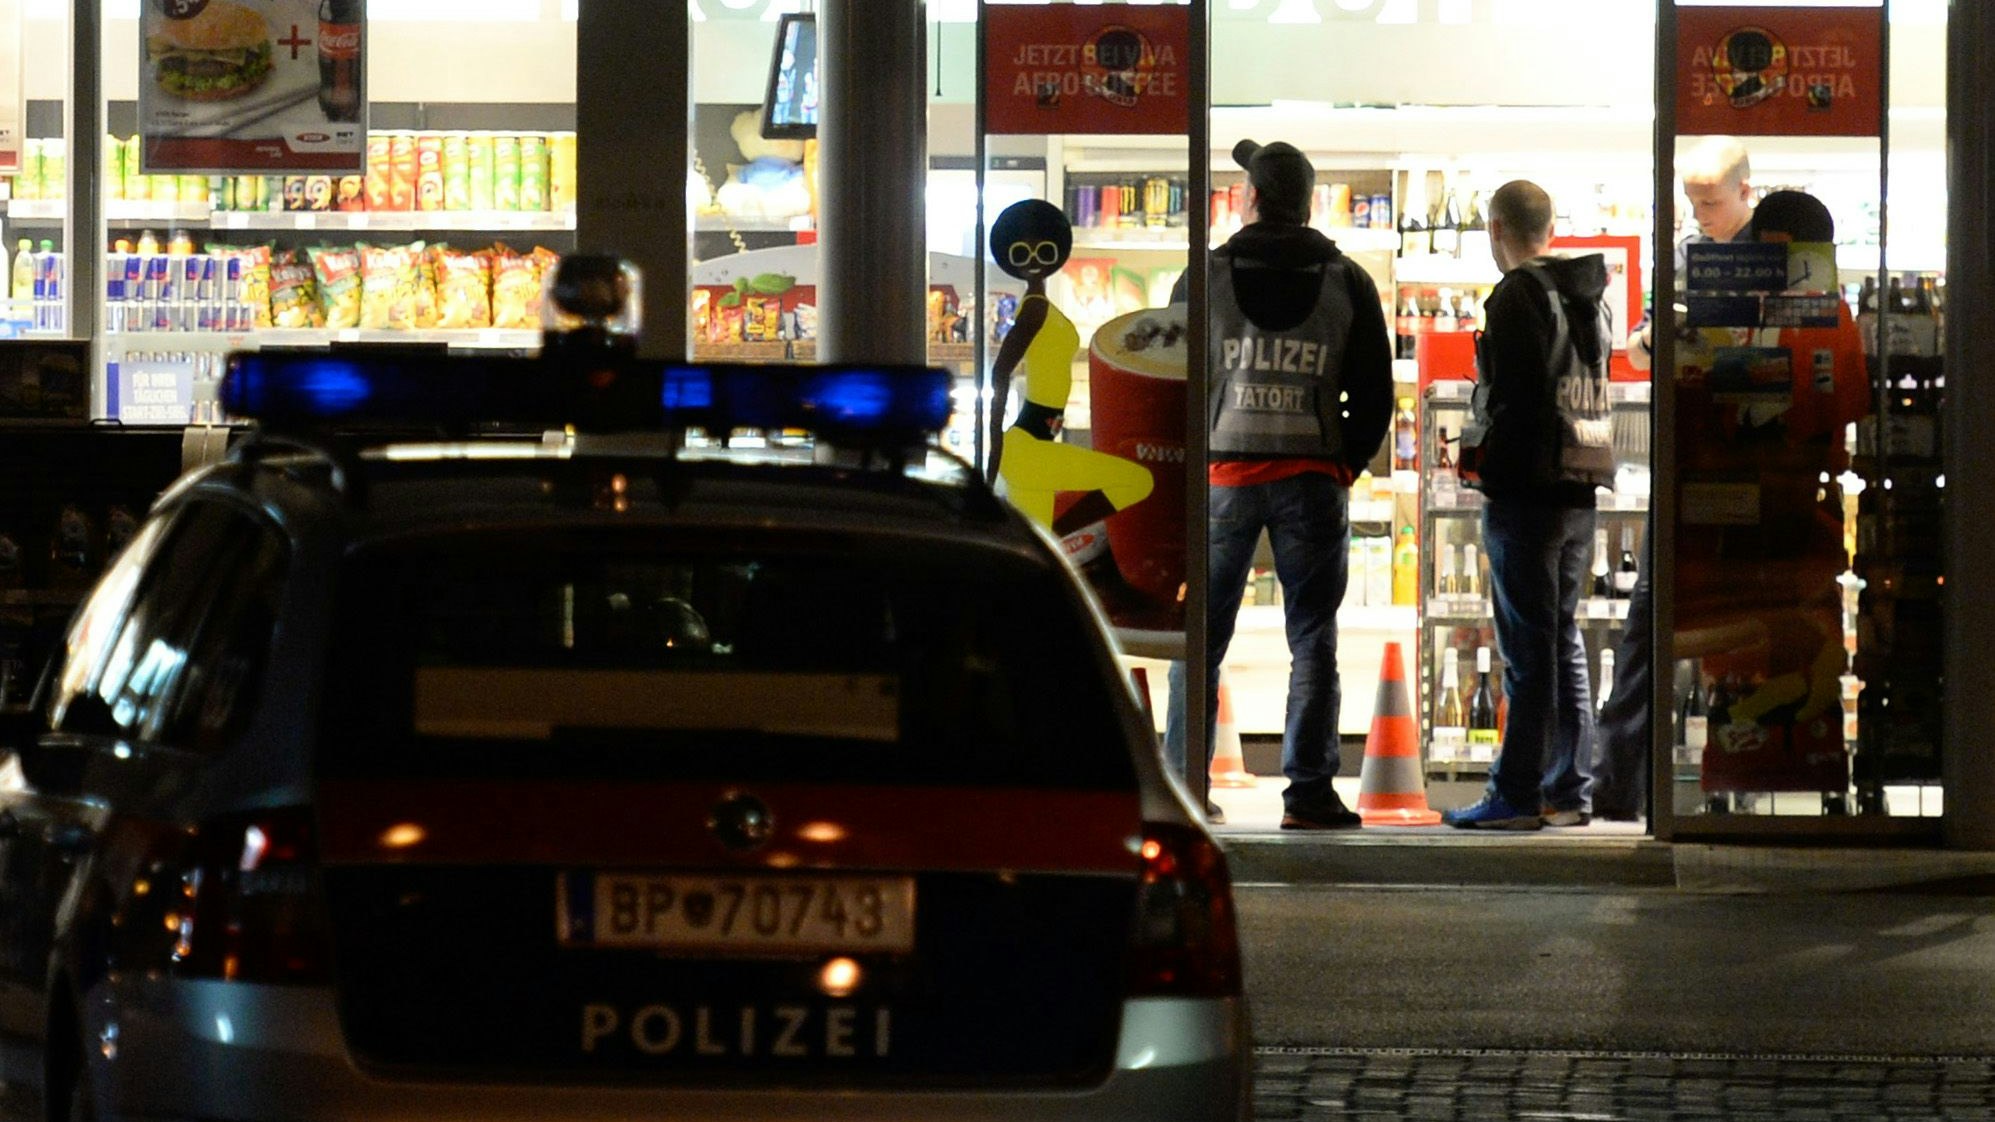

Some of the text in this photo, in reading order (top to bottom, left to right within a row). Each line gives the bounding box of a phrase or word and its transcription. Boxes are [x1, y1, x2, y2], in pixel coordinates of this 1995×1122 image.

[1013, 44, 1079, 66] JETZT
[1013, 71, 1079, 96] AFRO
[1223, 336, 1327, 376] POLIZEI
[1234, 385, 1304, 410] TATORT
[611, 881, 883, 938] BP 70743
[581, 1004, 890, 1057] POLIZEI
